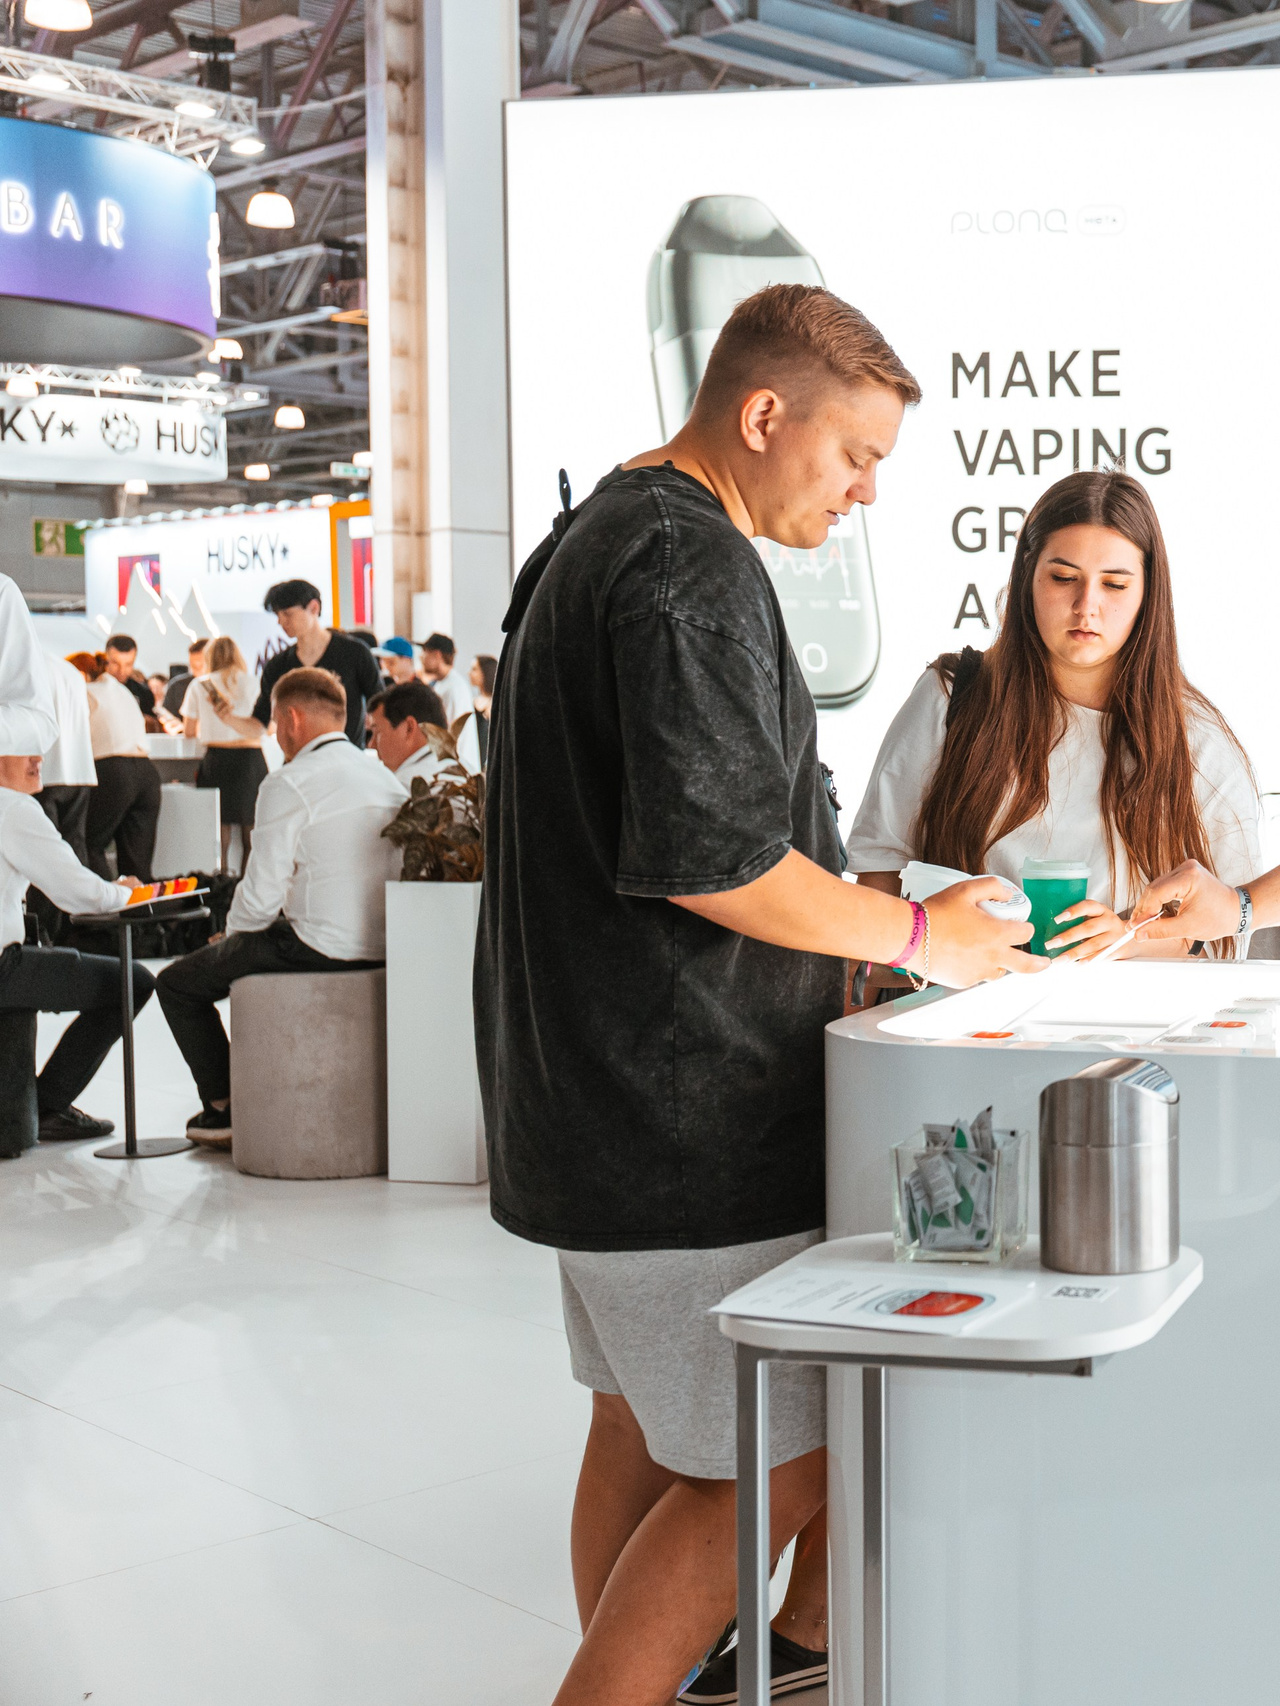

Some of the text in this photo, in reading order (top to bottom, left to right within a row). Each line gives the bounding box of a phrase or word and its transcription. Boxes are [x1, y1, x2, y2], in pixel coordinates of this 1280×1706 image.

[0, 178, 124, 250] BAR
[952, 349, 1121, 398] MAKE
[953, 427, 1172, 476] VAPING
[207, 533, 279, 573] HUSKY
[910, 910, 920, 946] SHOW
